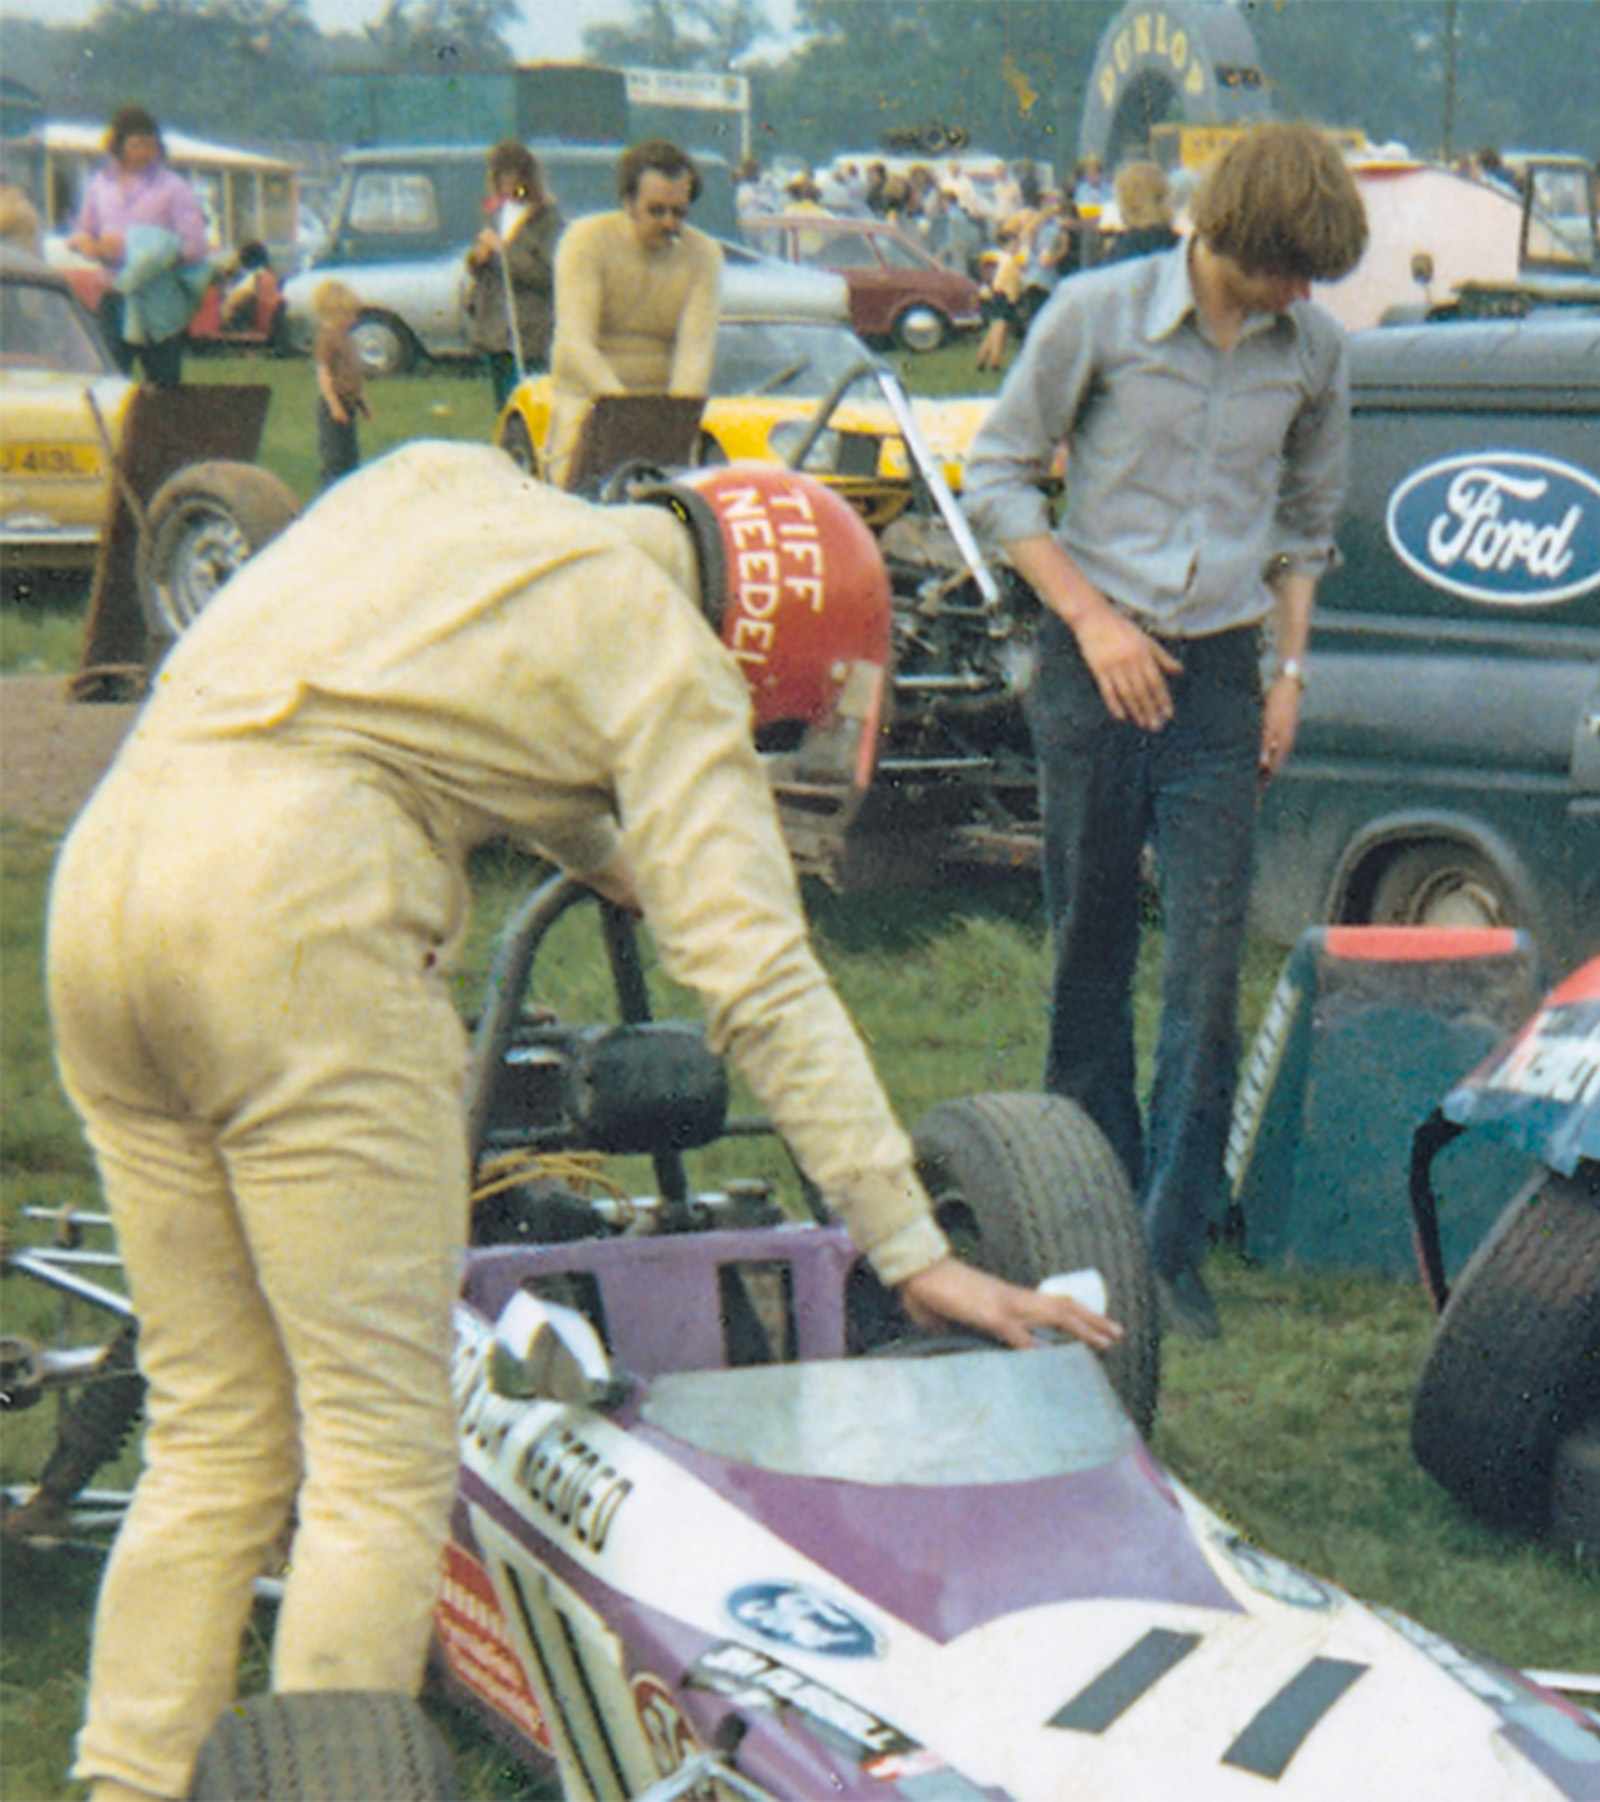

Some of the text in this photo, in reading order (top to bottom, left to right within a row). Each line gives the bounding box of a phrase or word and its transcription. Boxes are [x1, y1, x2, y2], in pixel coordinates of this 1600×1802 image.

[1099, 12, 1203, 108] DUNLOP
[771, 486, 824, 613] TIFF
[1428, 468, 1582, 578] Ford
[1043, 1626, 1373, 1783] 11
